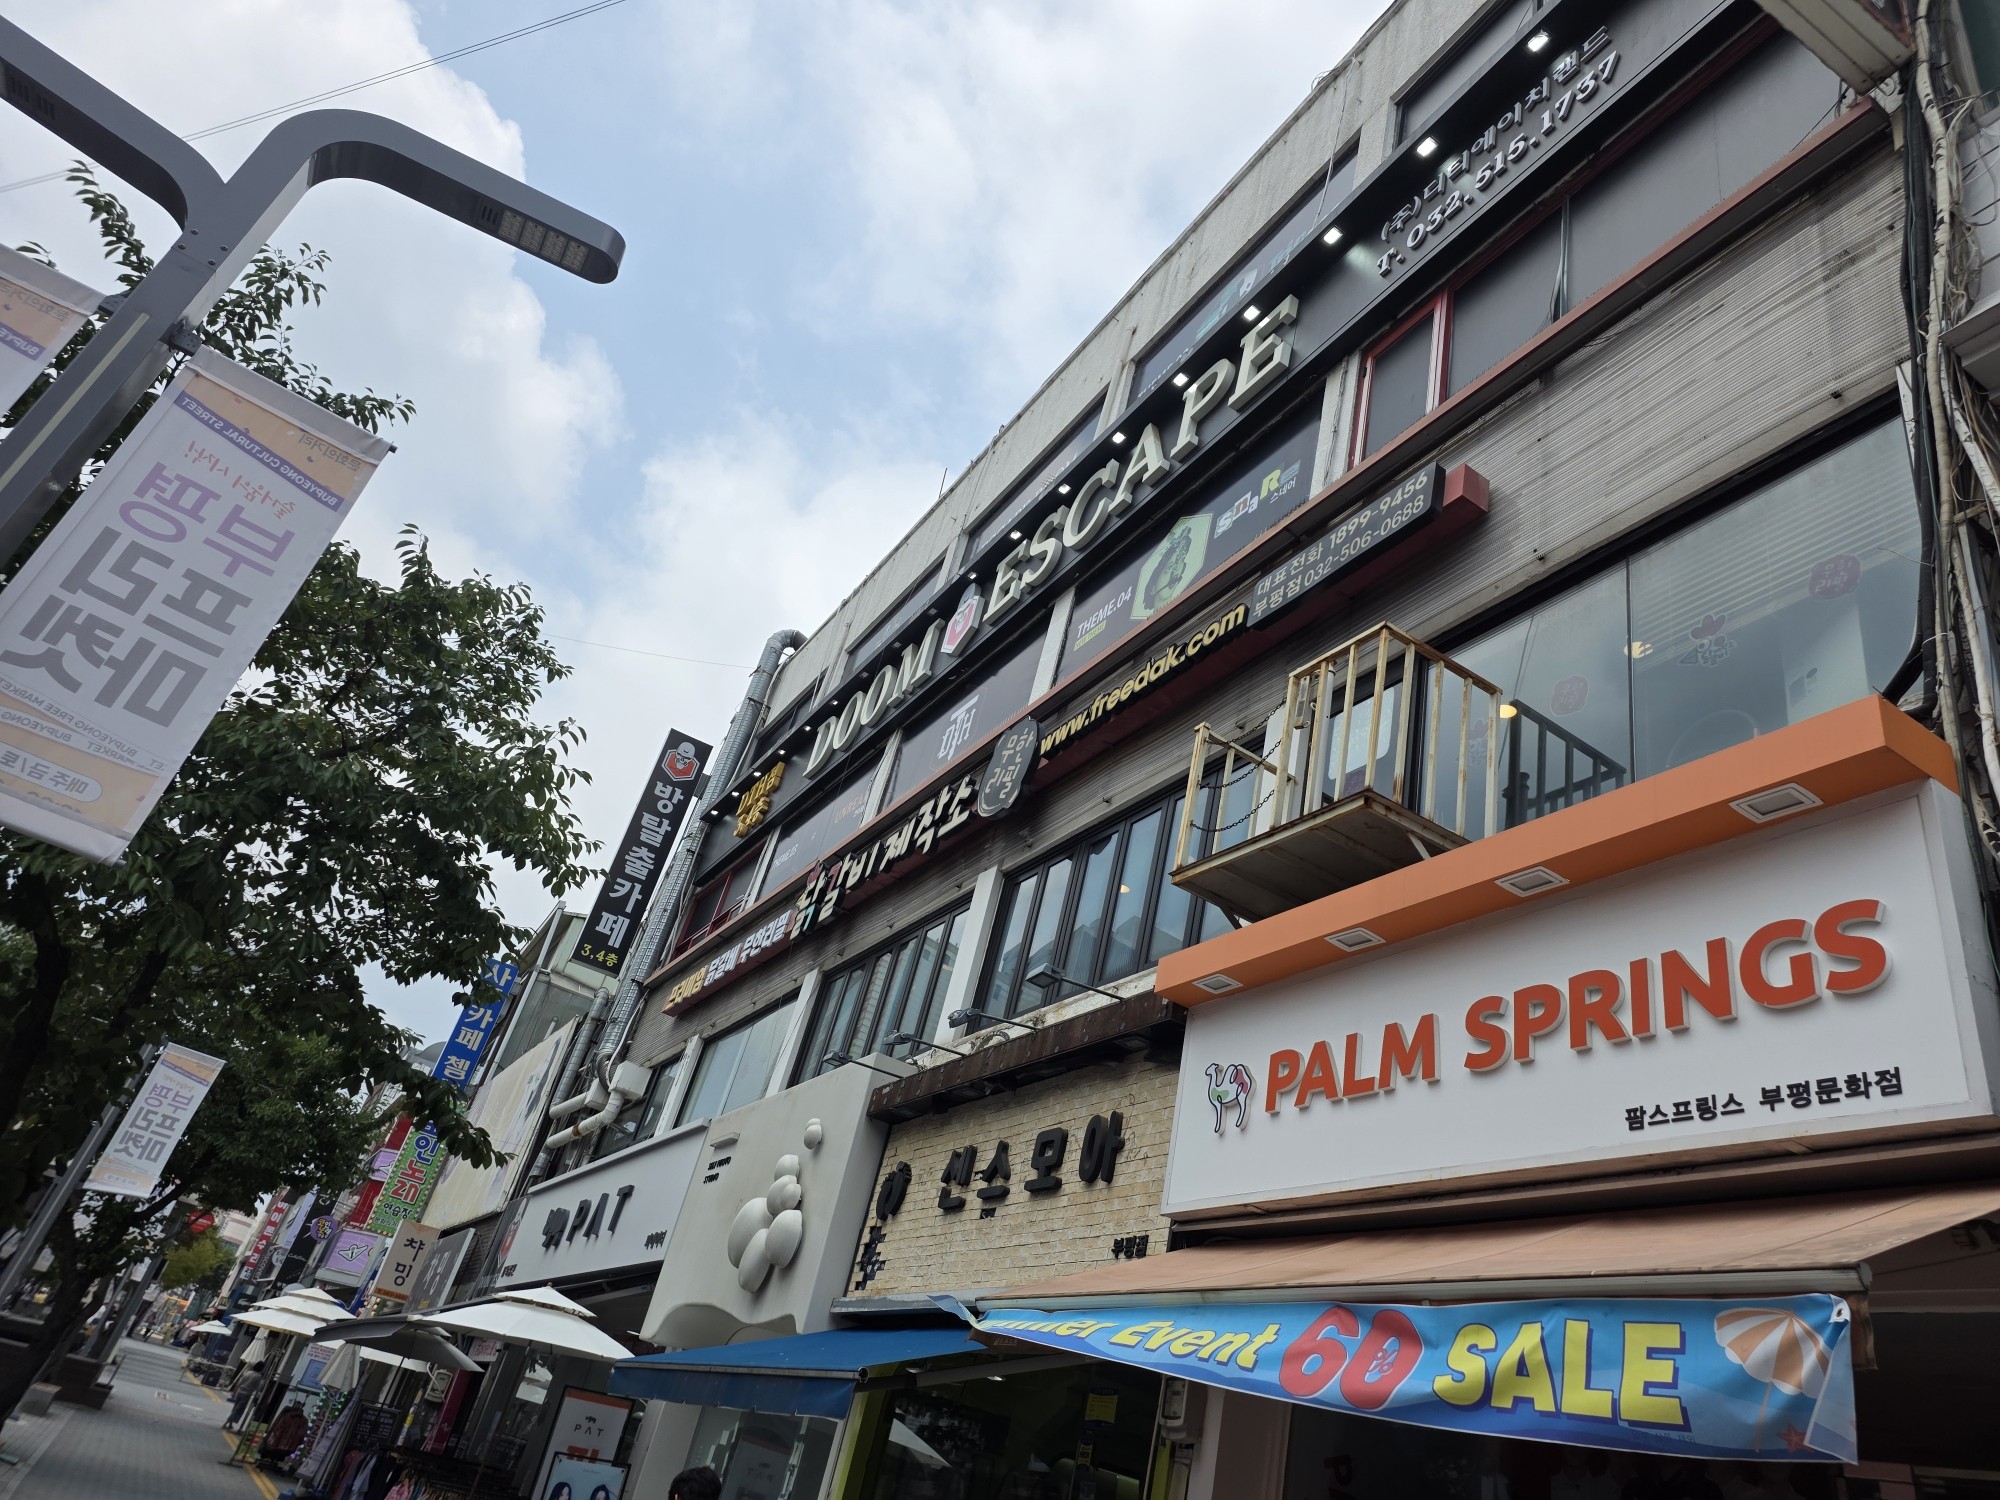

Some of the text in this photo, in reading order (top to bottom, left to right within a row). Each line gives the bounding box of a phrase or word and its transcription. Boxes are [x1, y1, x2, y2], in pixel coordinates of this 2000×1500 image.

[803, 617, 945, 780] DOOM
[983, 294, 1299, 624] ESCAPE
[1252, 493, 1424, 618] 부평점 032-506-0688
[1329, 471, 1428, 556] 1899-9456
[1039, 603, 1246, 757] www.freedak.com
[985, 762, 1018, 799] 리필
[1002, 728, 1034, 763] 무한
[1265, 899, 1892, 1115] PALM SPRINGS
[1625, 1065, 1904, 1131] 팜스프링스 부평문화점
[383, 1202, 412, 1220] 연습장
[1108, 1320, 1280, 1371] Event
[1431, 1319, 1691, 1432] SALE
